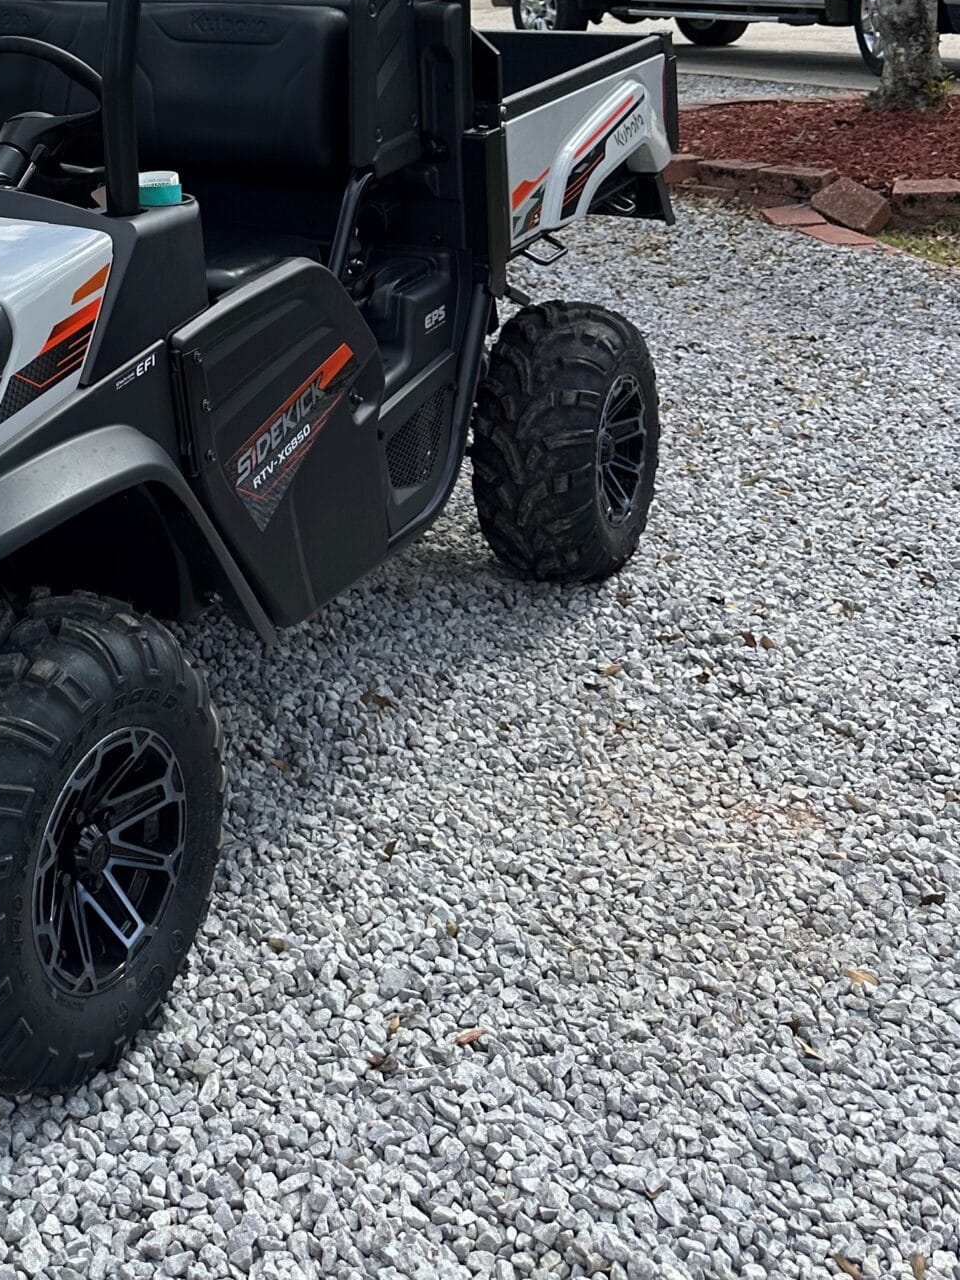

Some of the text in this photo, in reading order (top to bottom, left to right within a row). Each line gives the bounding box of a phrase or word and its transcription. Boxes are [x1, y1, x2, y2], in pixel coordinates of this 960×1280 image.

[613, 113, 644, 146] Kubota
[425, 304, 446, 329] EPS
[136, 353, 156, 377] EFI
[235, 374, 326, 487] SIDEKICK
[252, 424, 312, 489] RTV-XG850
